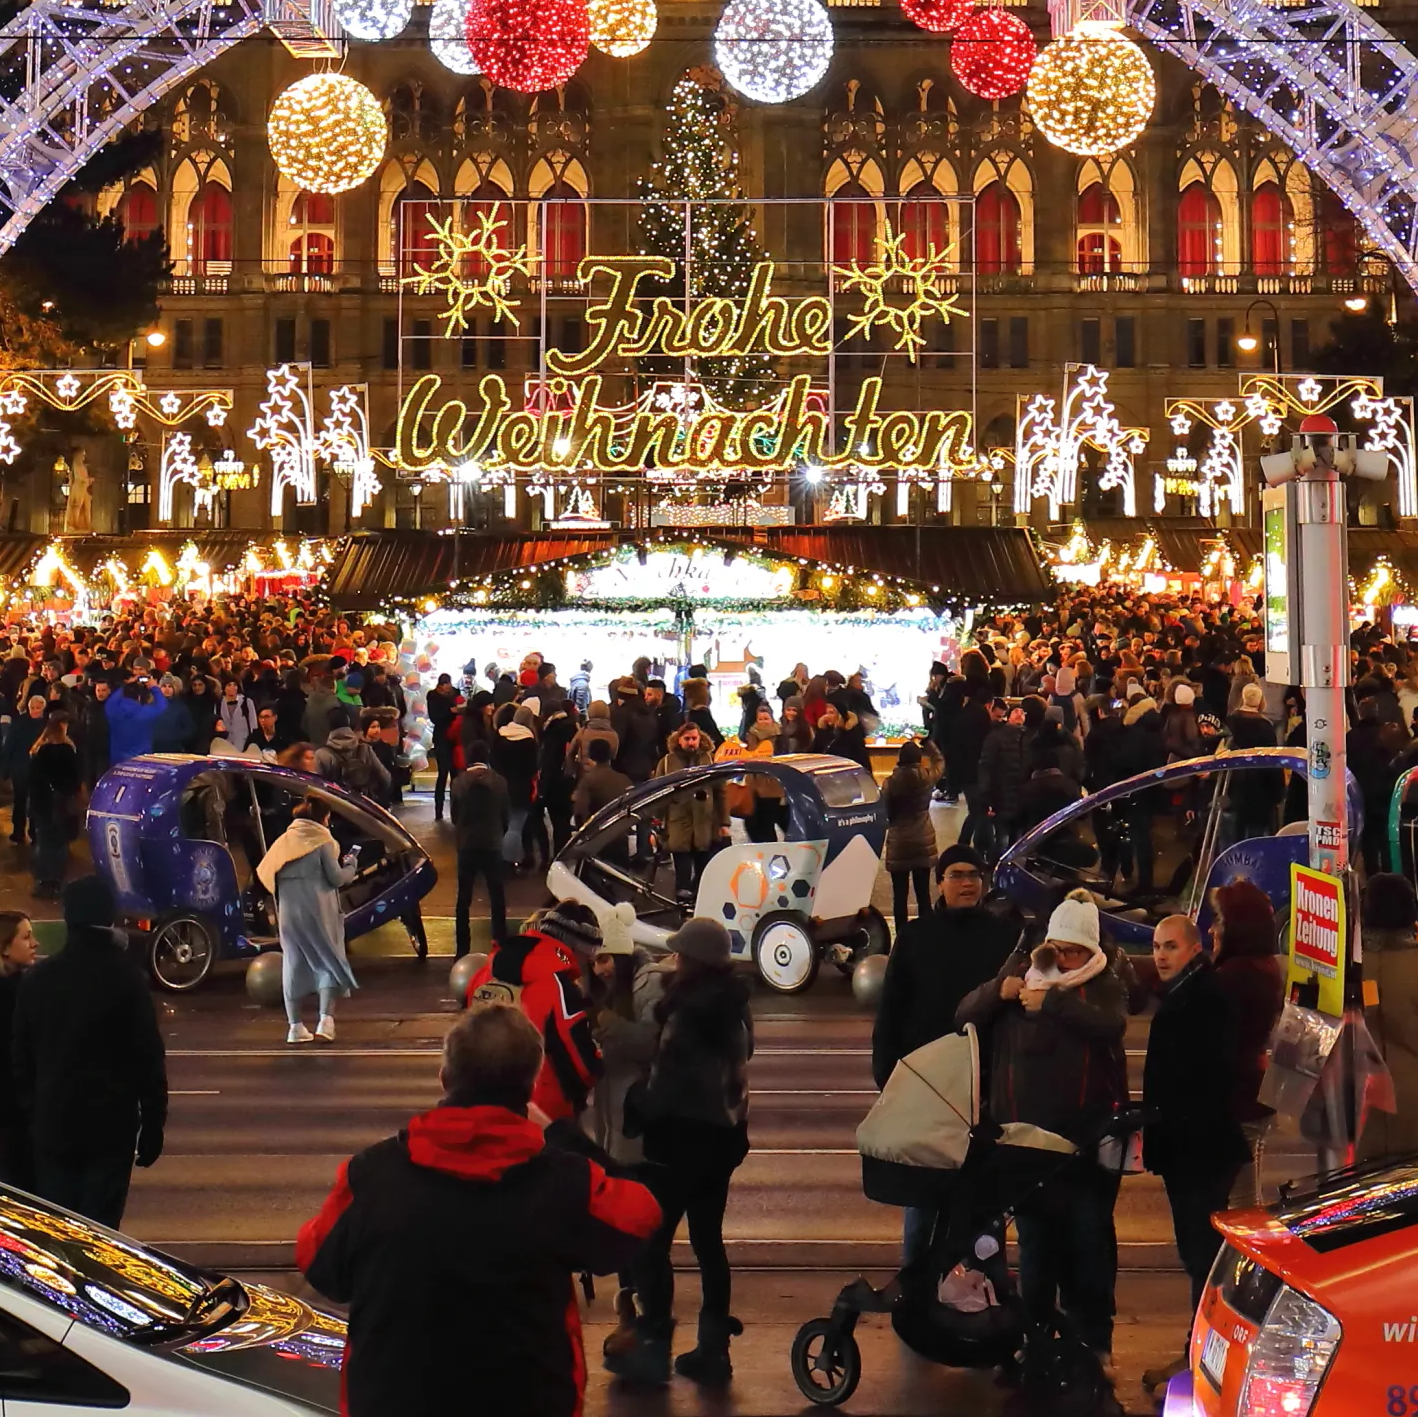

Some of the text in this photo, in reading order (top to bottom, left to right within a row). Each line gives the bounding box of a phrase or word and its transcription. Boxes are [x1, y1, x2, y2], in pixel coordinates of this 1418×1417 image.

[545, 254, 834, 377] Frohe
[394, 372, 980, 472] Weihnachten
[725, 748, 742, 757] FAXI
[1317, 826, 1341, 836] TSC
[1297, 881, 1339, 923] Kronen
[1296, 912, 1338, 958] Zeitung
[1233, 1324, 1249, 1344] ORF
